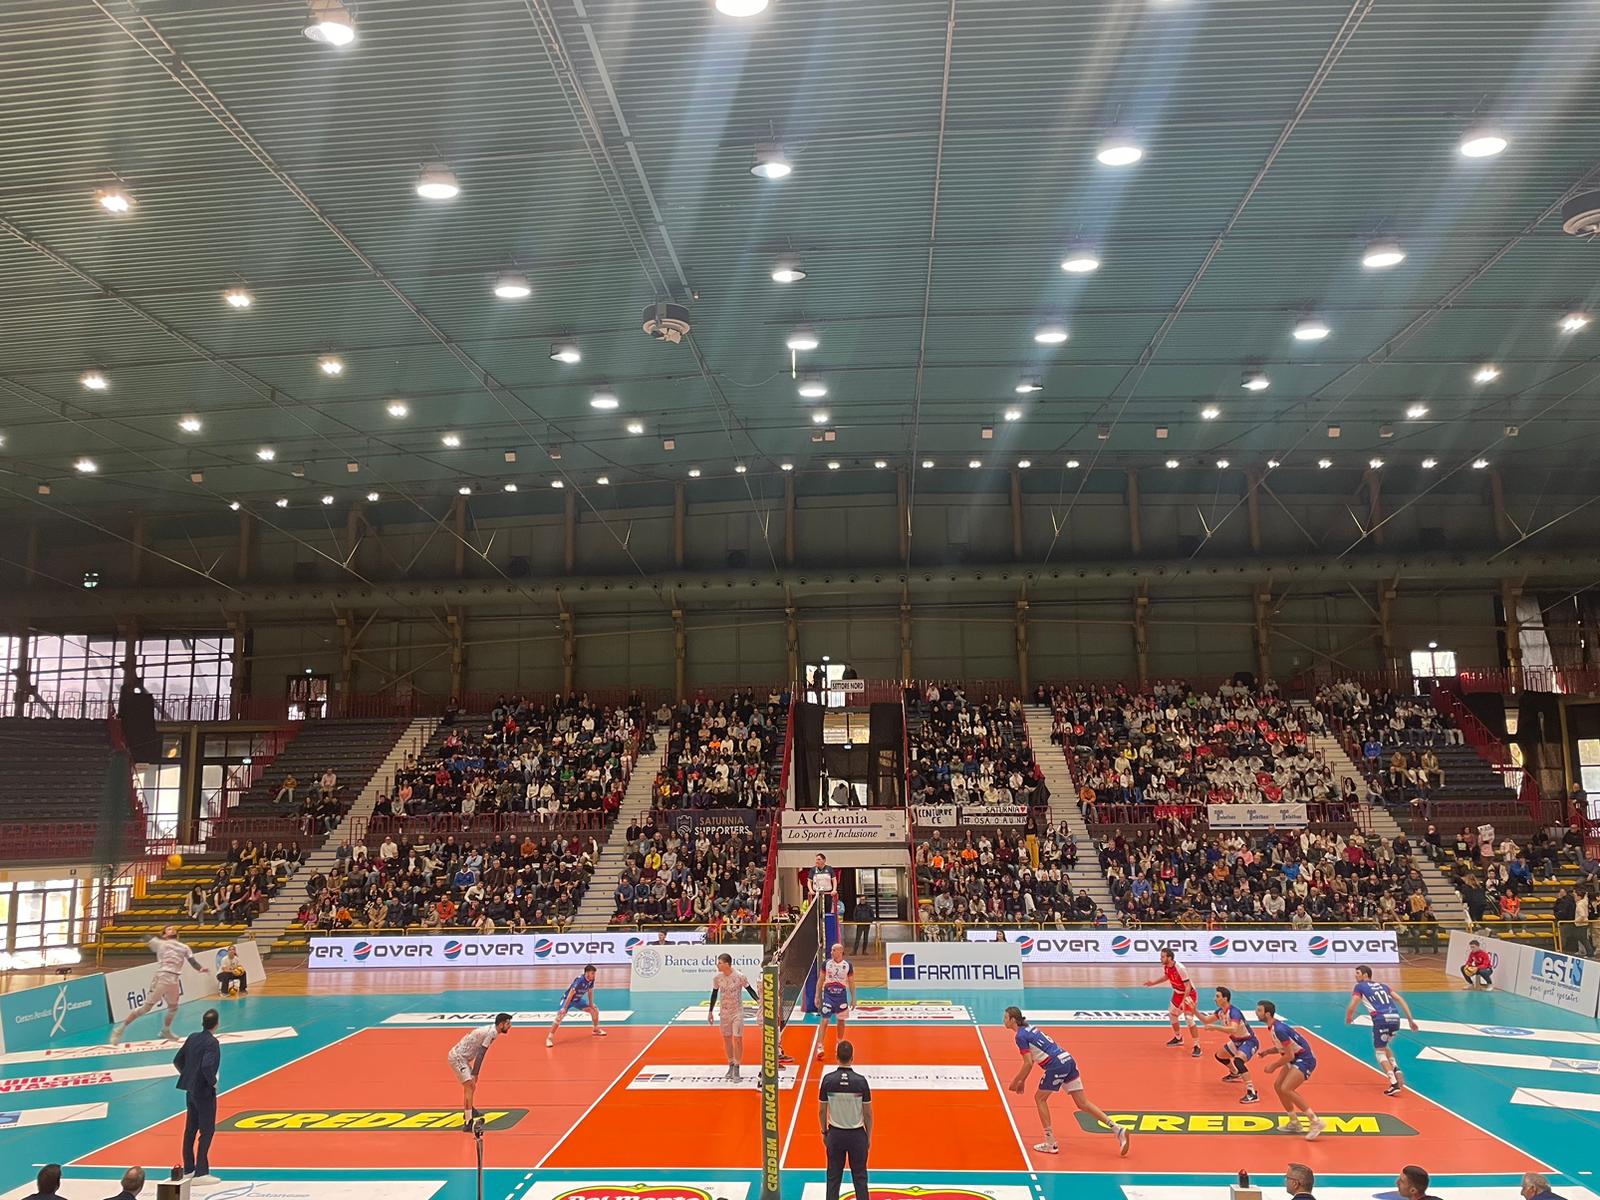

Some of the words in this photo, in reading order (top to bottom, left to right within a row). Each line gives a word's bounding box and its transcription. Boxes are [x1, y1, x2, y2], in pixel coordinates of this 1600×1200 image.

[699, 816, 745, 825] SATURNIA
[798, 813, 808, 825] A
[813, 811, 868, 825] Catania
[694, 825, 751, 835] SUPPORTERS
[788, 829, 800, 839] Lo
[802, 829, 827, 841] Sport
[835, 828, 879, 839] Inclusione
[374, 944, 433, 957] OVER
[464, 943, 524, 956] OVER
[555, 941, 615, 954] OVER
[1037, 938, 1100, 952] OVER
[1232, 938, 1298, 952] OVER
[665, 954, 700, 966] Banca
[701, 954, 718, 966] del
[731, 954, 761, 966] ucino
[917, 964, 1020, 980] FARMITALIA
[764, 973, 774, 1020] BANCA
[1374, 990, 1390, 1005] 17
[765, 1026, 775, 1078] CREDEM
[765, 1084, 776, 1131] BANCA
[234, 1112, 510, 1129] CREDEM
[1097, 1114, 1381, 1133] CREDEM
[766, 1137, 777, 1192] CREDEM
